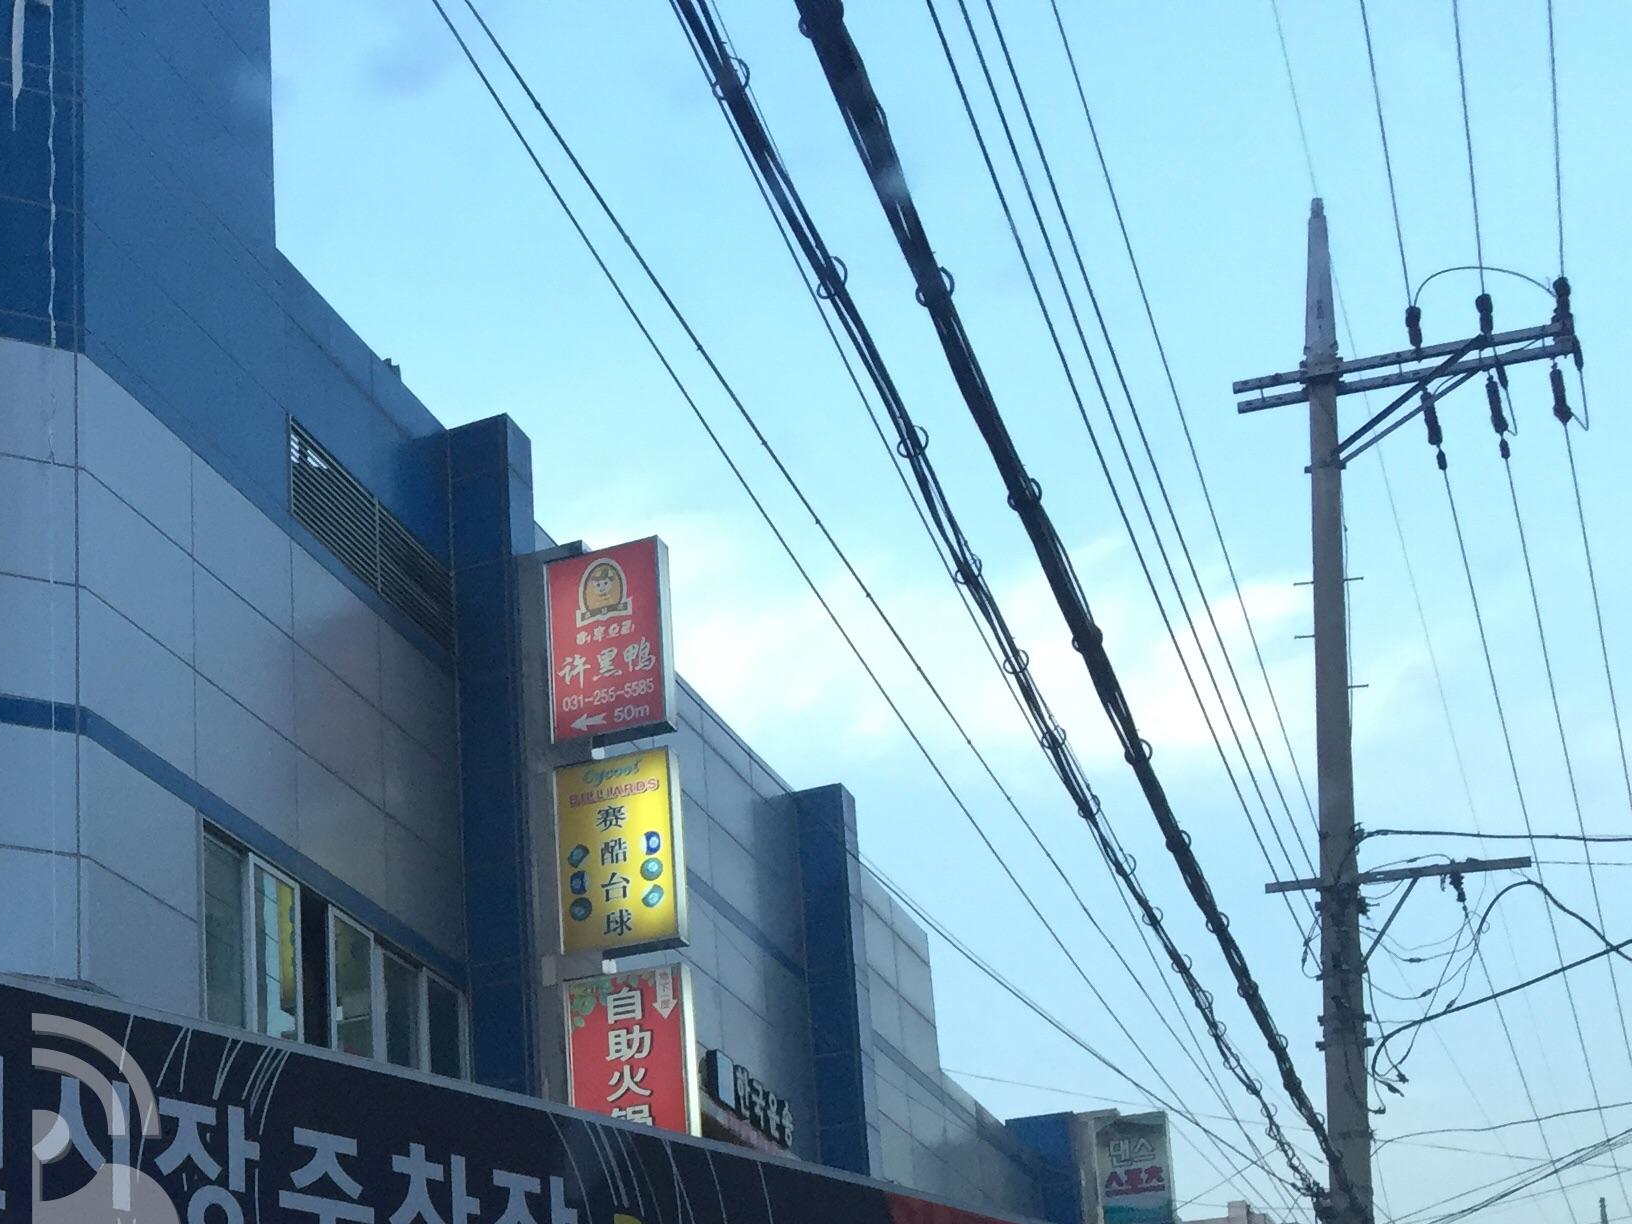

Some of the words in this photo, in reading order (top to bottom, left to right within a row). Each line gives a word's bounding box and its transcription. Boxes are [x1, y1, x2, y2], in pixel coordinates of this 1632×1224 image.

[613, 703, 650, 723] 50m
[569, 778, 660, 808] BILLIARDS
[595, 805, 633, 936] 赛酷台球
[735, 1064, 795, 1148] 한국운송
[1108, 1138, 1156, 1168] 댄스
[1104, 1165, 1166, 1198] 스포츠
